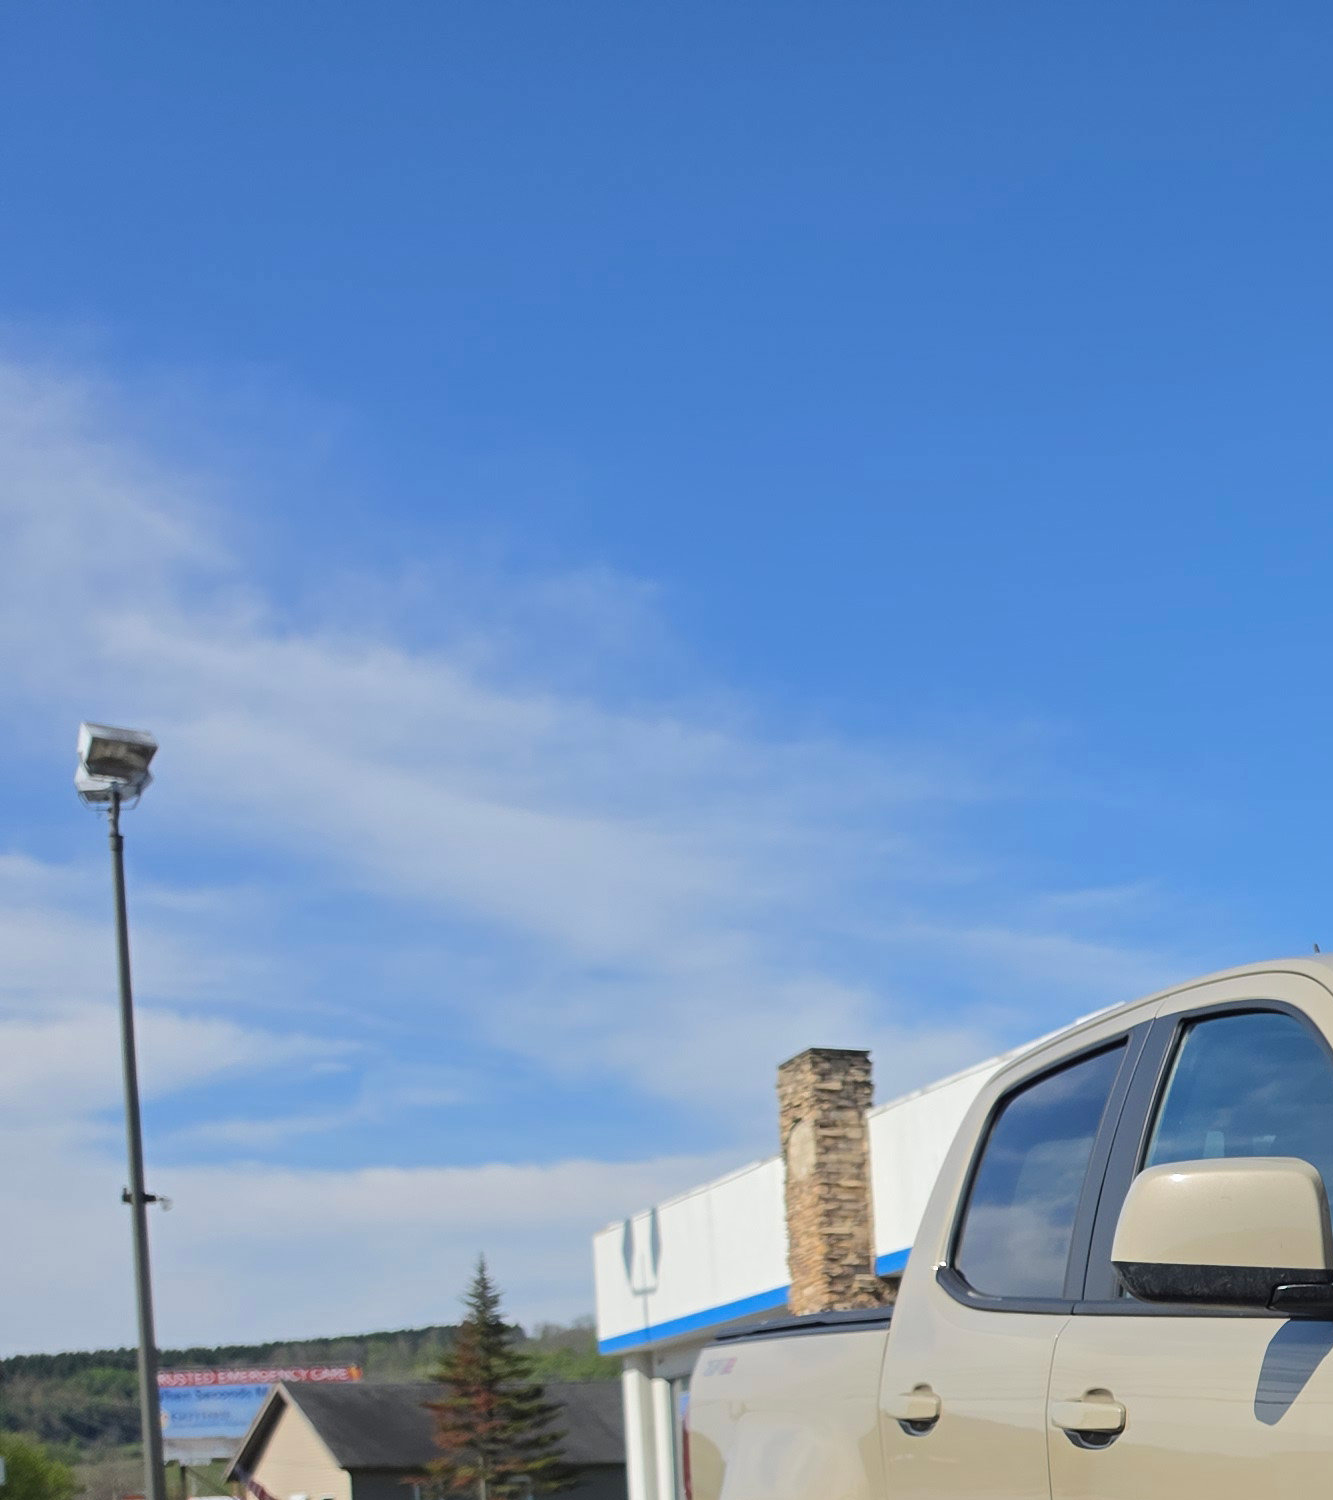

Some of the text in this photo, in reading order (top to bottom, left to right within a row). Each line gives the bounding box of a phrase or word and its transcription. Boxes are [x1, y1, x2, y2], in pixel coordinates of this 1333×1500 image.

[157, 1366, 348, 1386] RUSTED EMERGENCY CARE
